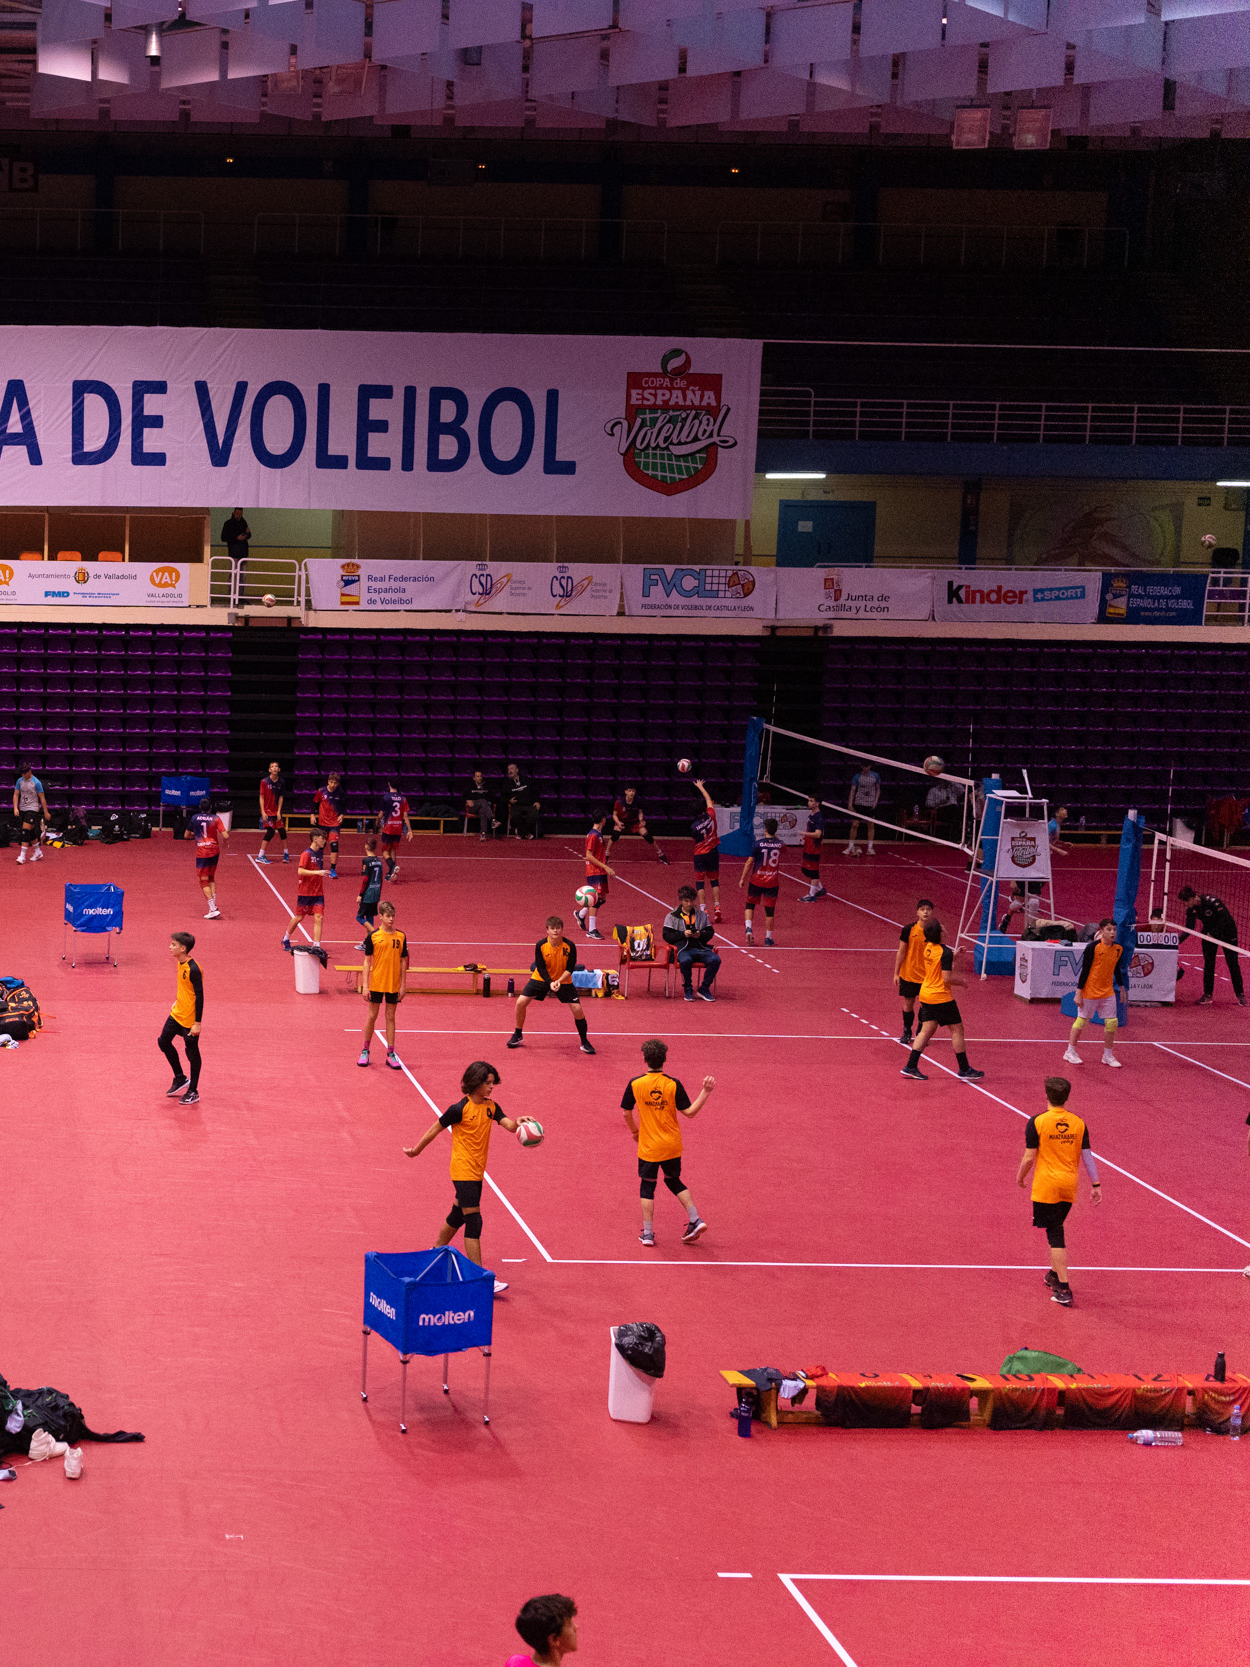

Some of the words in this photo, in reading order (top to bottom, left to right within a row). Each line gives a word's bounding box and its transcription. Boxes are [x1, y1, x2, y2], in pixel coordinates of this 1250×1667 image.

[642, 377, 671, 388] COPA
[673, 378, 688, 388] de
[630, 386, 717, 406] ESPAÑA
[70, 379, 169, 466] DE
[193, 379, 577, 476] VOLEIBOL
[604, 404, 738, 457] Voleibol
[28, 572, 71, 580] Ayuntamiento
[153, 571, 176, 584] VA!
[642, 568, 719, 598] FVCL
[367, 586, 406, 595] Española
[470, 573, 493, 595] CSD
[550, 576, 574, 598] CSD
[1131, 585, 1145, 594] REAL
[1146, 585, 1181, 595] FEDERACIÓN
[44, 590, 70, 598] FMD
[844, 593, 874, 603] Junta
[877, 593, 890, 603] de
[947, 580, 1028, 605] Kinder
[379, 597, 413, 605] Voleibol
[818, 603, 852, 613] Castilla
[855, 606, 862, 614] y
[864, 602, 890, 613] León
[1129, 597, 1158, 608] ESPAÑOLA
[1159, 599, 1166, 608] DE
[1167, 599, 1194, 609] VOLEIBOL
[392, 801, 401, 817] 3
[201, 822, 207, 838] 1
[761, 848, 781, 868] 18
[373, 867, 379, 881] 7
[83, 907, 113, 915] molten
[392, 938, 400, 949] 19
[369, 1291, 396, 1320] molten
[418, 1310, 474, 1326] molten
